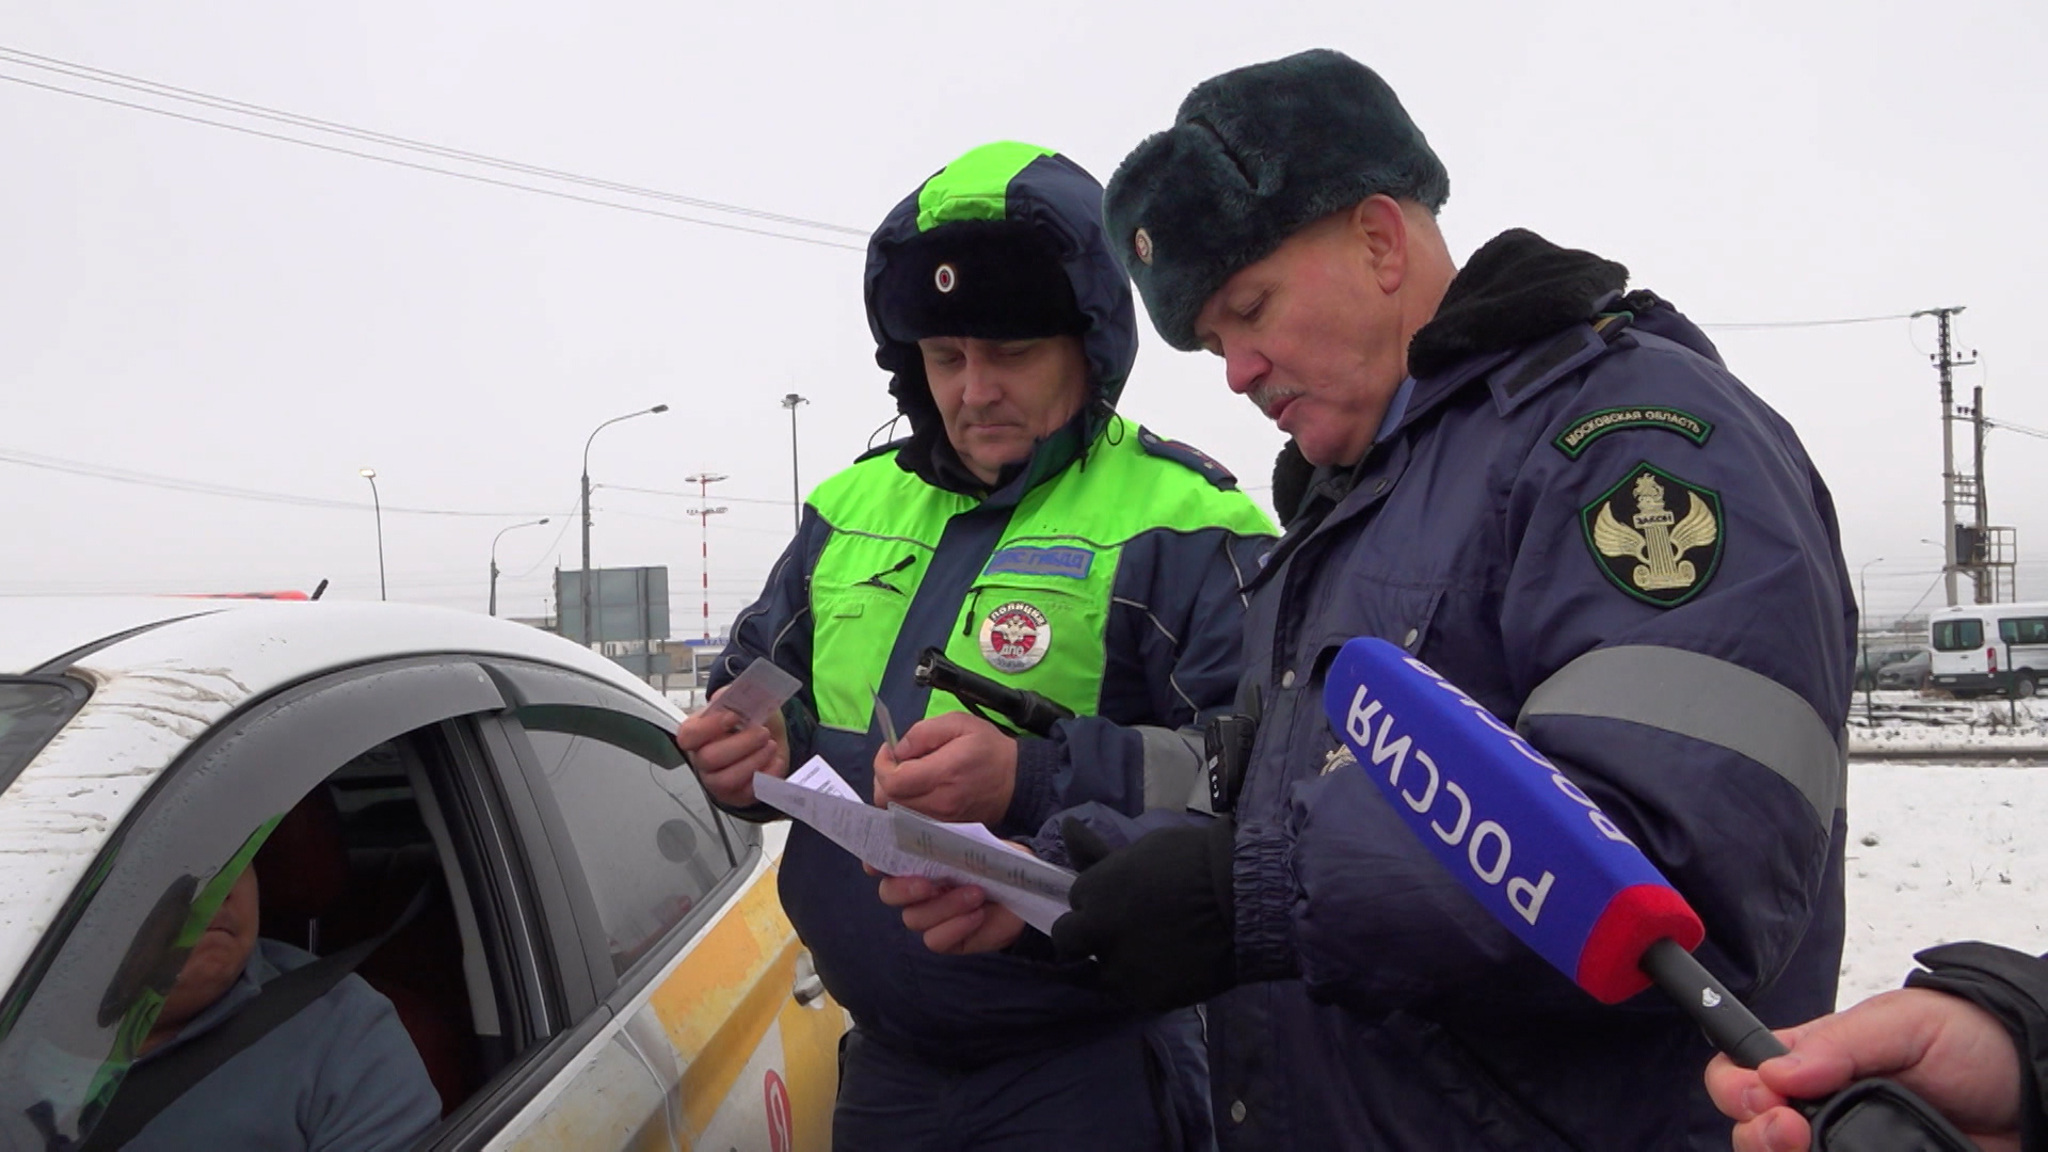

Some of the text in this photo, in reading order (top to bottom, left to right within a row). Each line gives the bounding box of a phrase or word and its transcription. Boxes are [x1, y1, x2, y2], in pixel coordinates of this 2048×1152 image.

[1565, 410, 1700, 447] МОСКОВСКАЯ ОБЛАСТЬ
[1635, 514, 1673, 524] ЗАКОН
[991, 602, 1046, 626] ПОЛИЦИЯ
[1345, 684, 1556, 926] РОССИЯ
